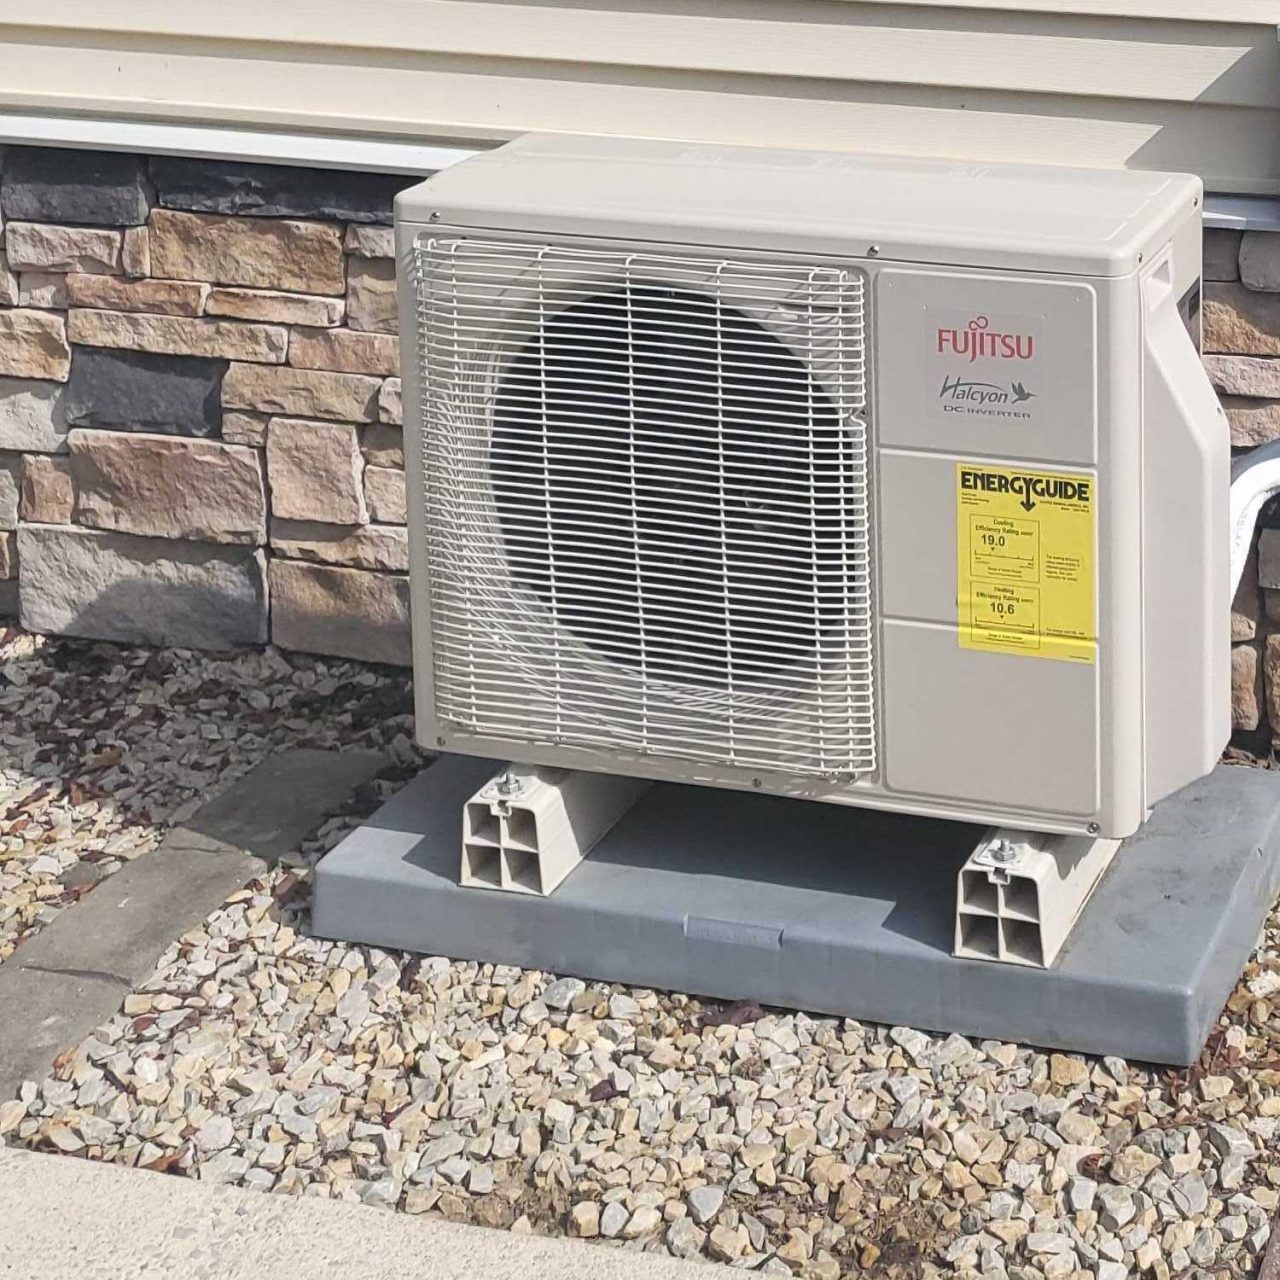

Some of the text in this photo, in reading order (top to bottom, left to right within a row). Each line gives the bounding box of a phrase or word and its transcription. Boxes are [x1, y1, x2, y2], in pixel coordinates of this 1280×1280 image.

[937, 326, 1034, 363] FUJITSU
[939, 375, 1009, 405] Halcyon
[943, 405, 1031, 419] DC INVERTER
[961, 471, 1090, 503] ENERGYGUIDE
[981, 534, 1006, 547] 19.0
[990, 601, 1015, 615] 10.6
